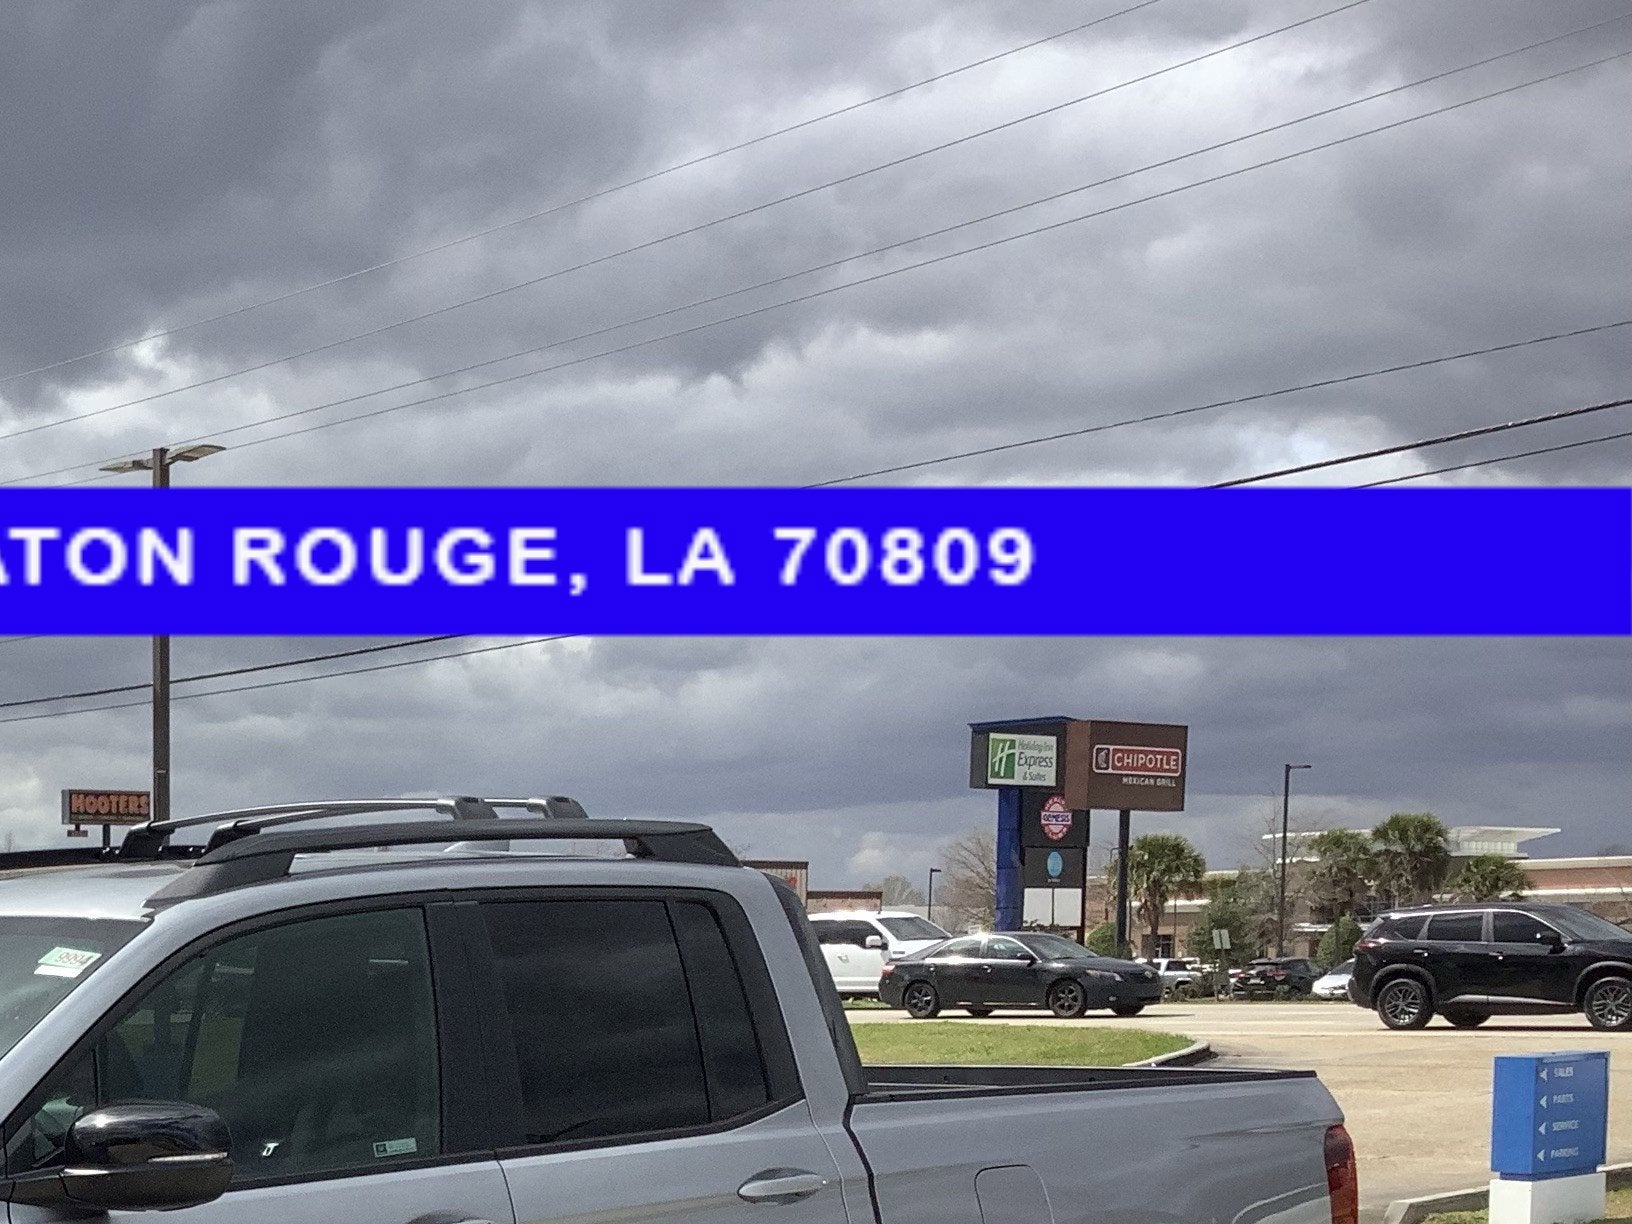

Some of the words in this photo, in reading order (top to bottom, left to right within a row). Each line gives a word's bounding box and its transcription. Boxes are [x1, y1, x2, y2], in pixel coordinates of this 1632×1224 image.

[1018, 751, 1054, 770] Express
[1114, 753, 1178, 769] CHIPOTLE
[1122, 776, 1155, 786] MEXICAN
[1156, 777, 1176, 787] GRILL
[71, 793, 149, 814] HOOTERS
[1552, 1120, 1579, 1131] SERVICE
